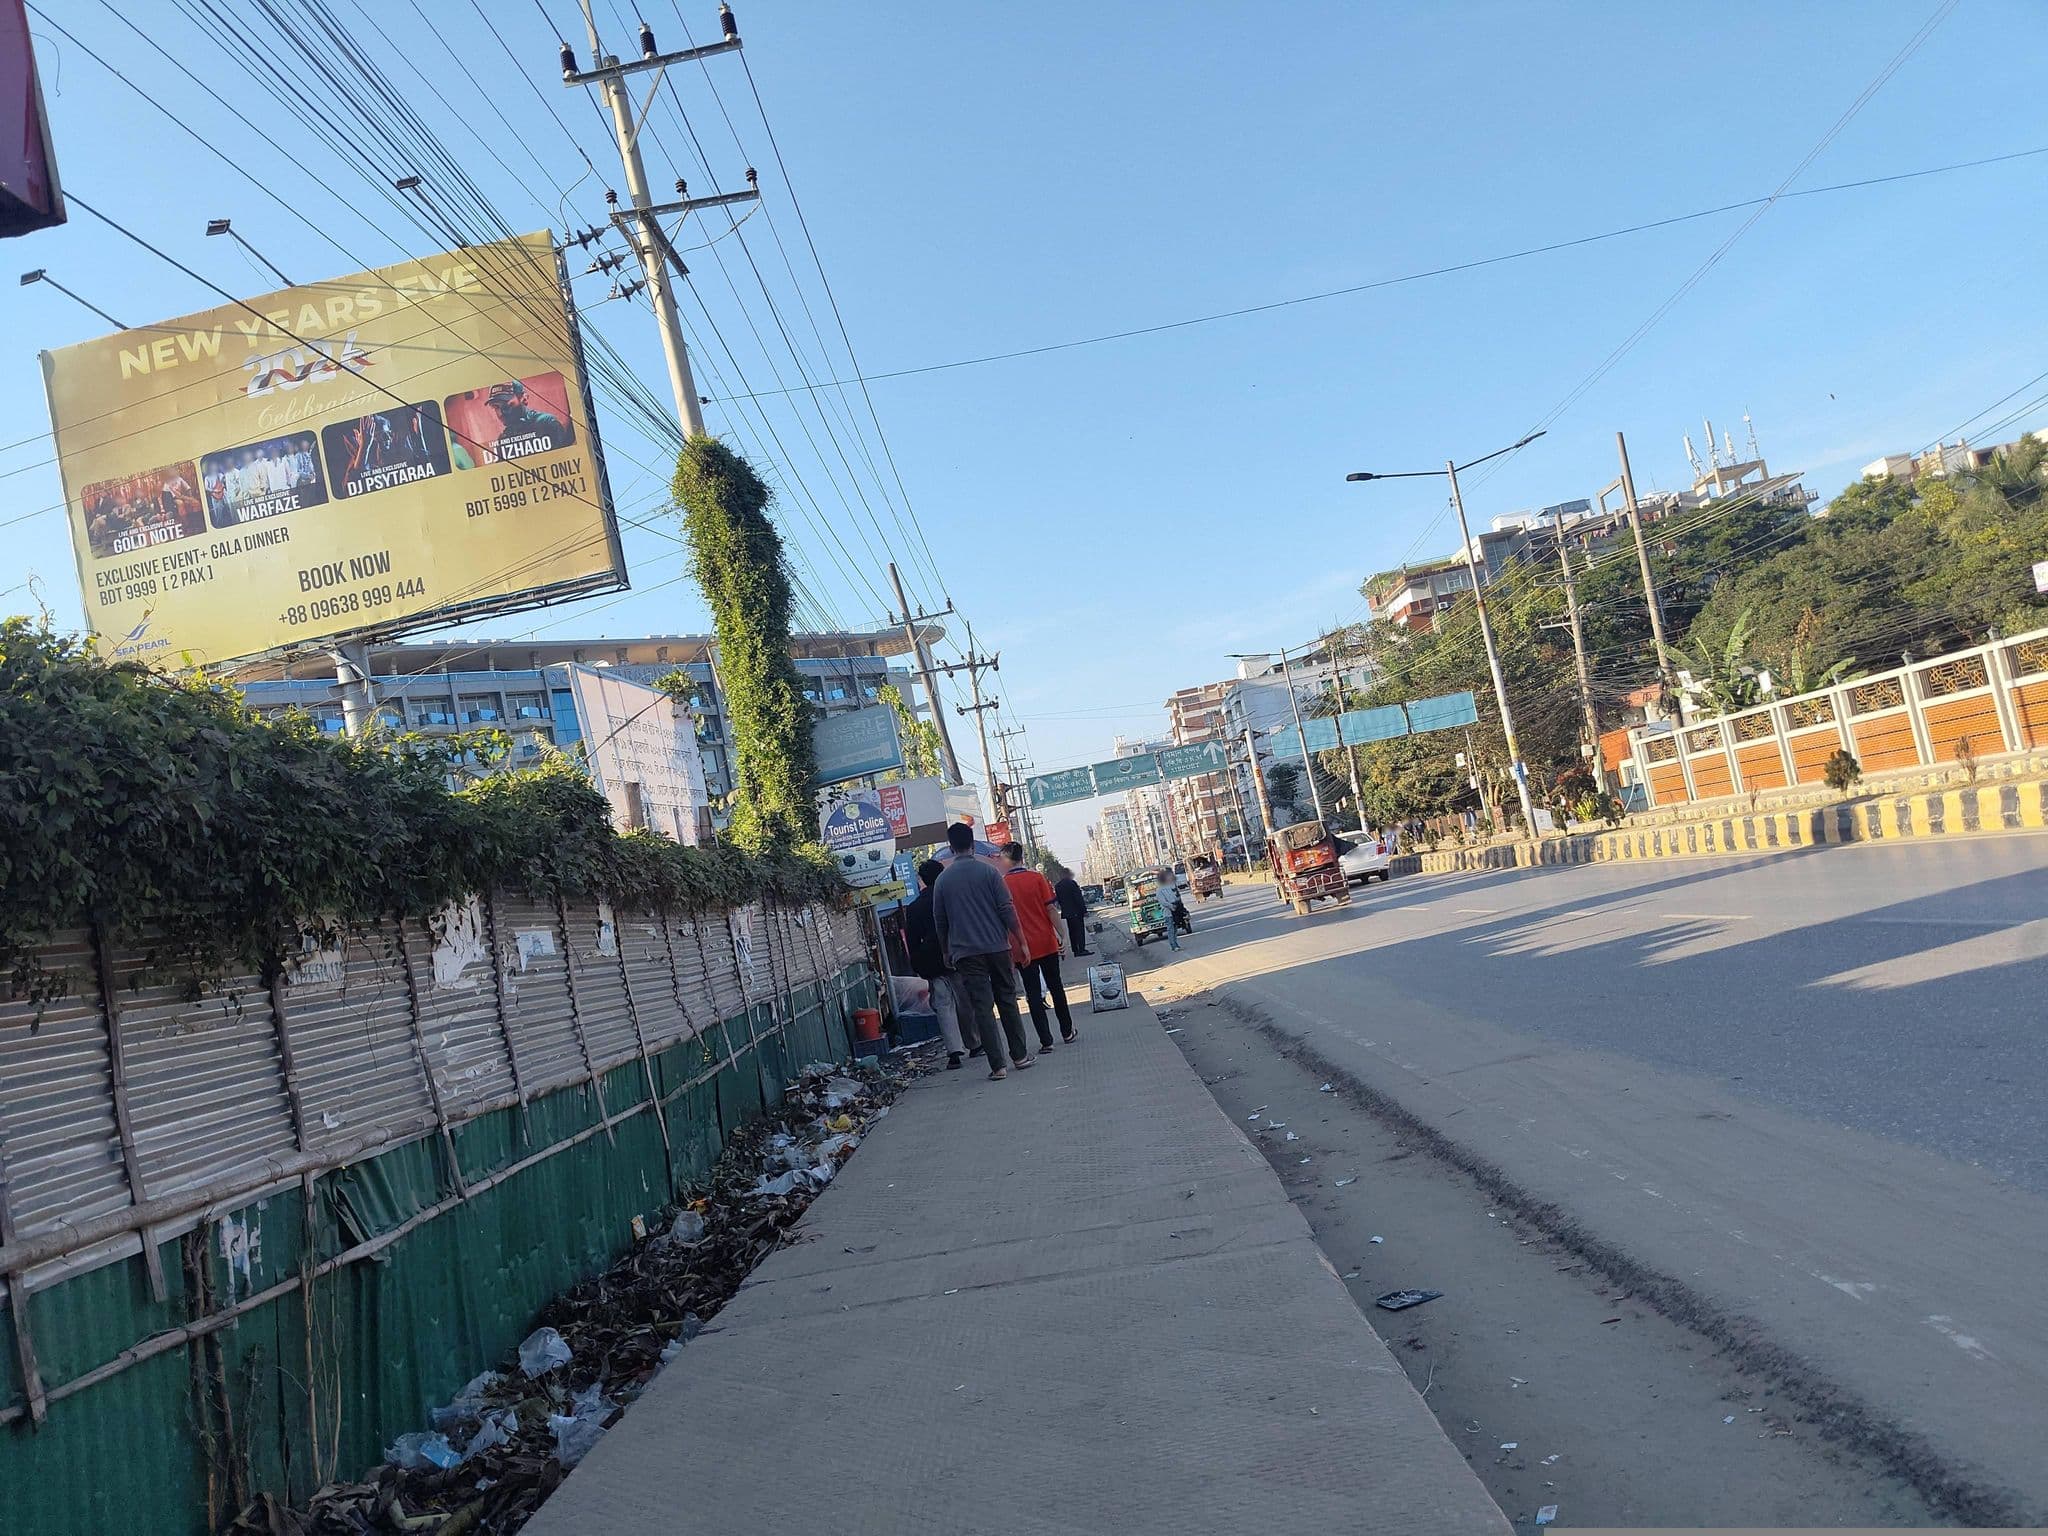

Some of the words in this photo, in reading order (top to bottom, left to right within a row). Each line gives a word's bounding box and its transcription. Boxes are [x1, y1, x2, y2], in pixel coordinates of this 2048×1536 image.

[119, 325, 223, 381] NEW
[234, 287, 383, 349] YEARS
[394, 262, 482, 309] EVE
[257, 390, 381, 431] Celebration
[481, 449, 499, 466] DJ
[501, 435, 552, 461] IZHAQO
[347, 480, 363, 497] DJ
[365, 462, 437, 492] PSYTARAA
[490, 476, 506, 493] DJ
[507, 465, 548, 490] EVENT
[550, 457, 582, 480] ONLY
[237, 494, 302, 523] WARFAZE
[465, 498, 490, 518] BDT
[493, 490, 527, 513] 5999
[540, 485, 550, 502] 2
[552, 478, 578, 500] PAX
[96, 558, 161, 588] EXCLUSIVE
[162, 548, 209, 573] EVENT+
[211, 538, 244, 560] GALA
[244, 526, 291, 552] DINNER
[113, 531, 148, 555] GOLD
[150, 523, 185, 547] NOTE
[99, 587, 123, 607] BDT
[126, 579, 158, 601] 9999
[170, 573, 179, 590] 2
[181, 567, 208, 588] PAX
[298, 561, 348, 593] BOOK
[349, 550, 392, 581] NOW
[278, 605, 308, 626] +88
[310, 592, 360, 620] 09638
[361, 585, 392, 609] 999
[395, 576, 426, 600] 444
[116, 646, 137, 657] SEA
[136, 637, 172, 653] PEARL
[828, 821, 858, 836] Tourist
[858, 816, 884, 831] Police
